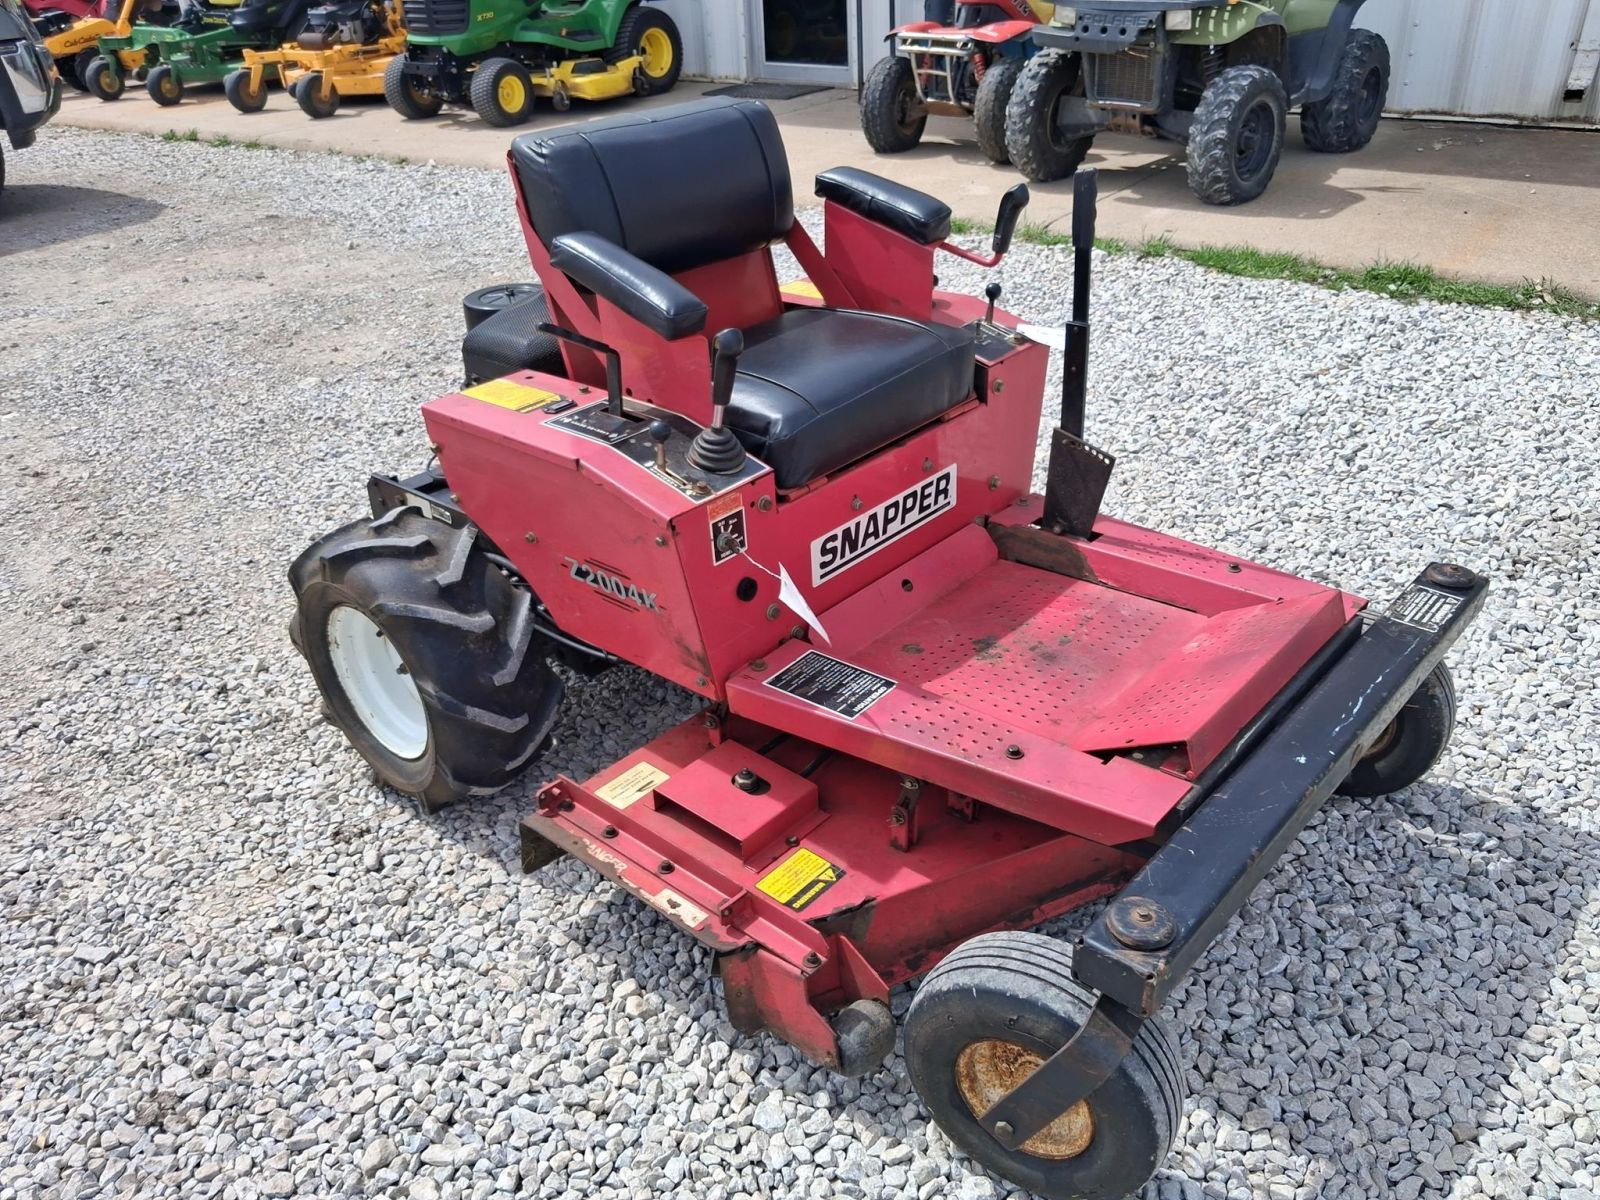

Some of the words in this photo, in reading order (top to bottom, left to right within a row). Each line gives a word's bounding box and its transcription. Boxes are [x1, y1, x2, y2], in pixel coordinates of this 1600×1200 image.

[1083, 14, 1148, 28] POLARIS
[819, 471, 951, 570] SNAPPER
[792, 881, 826, 909] WARNING
